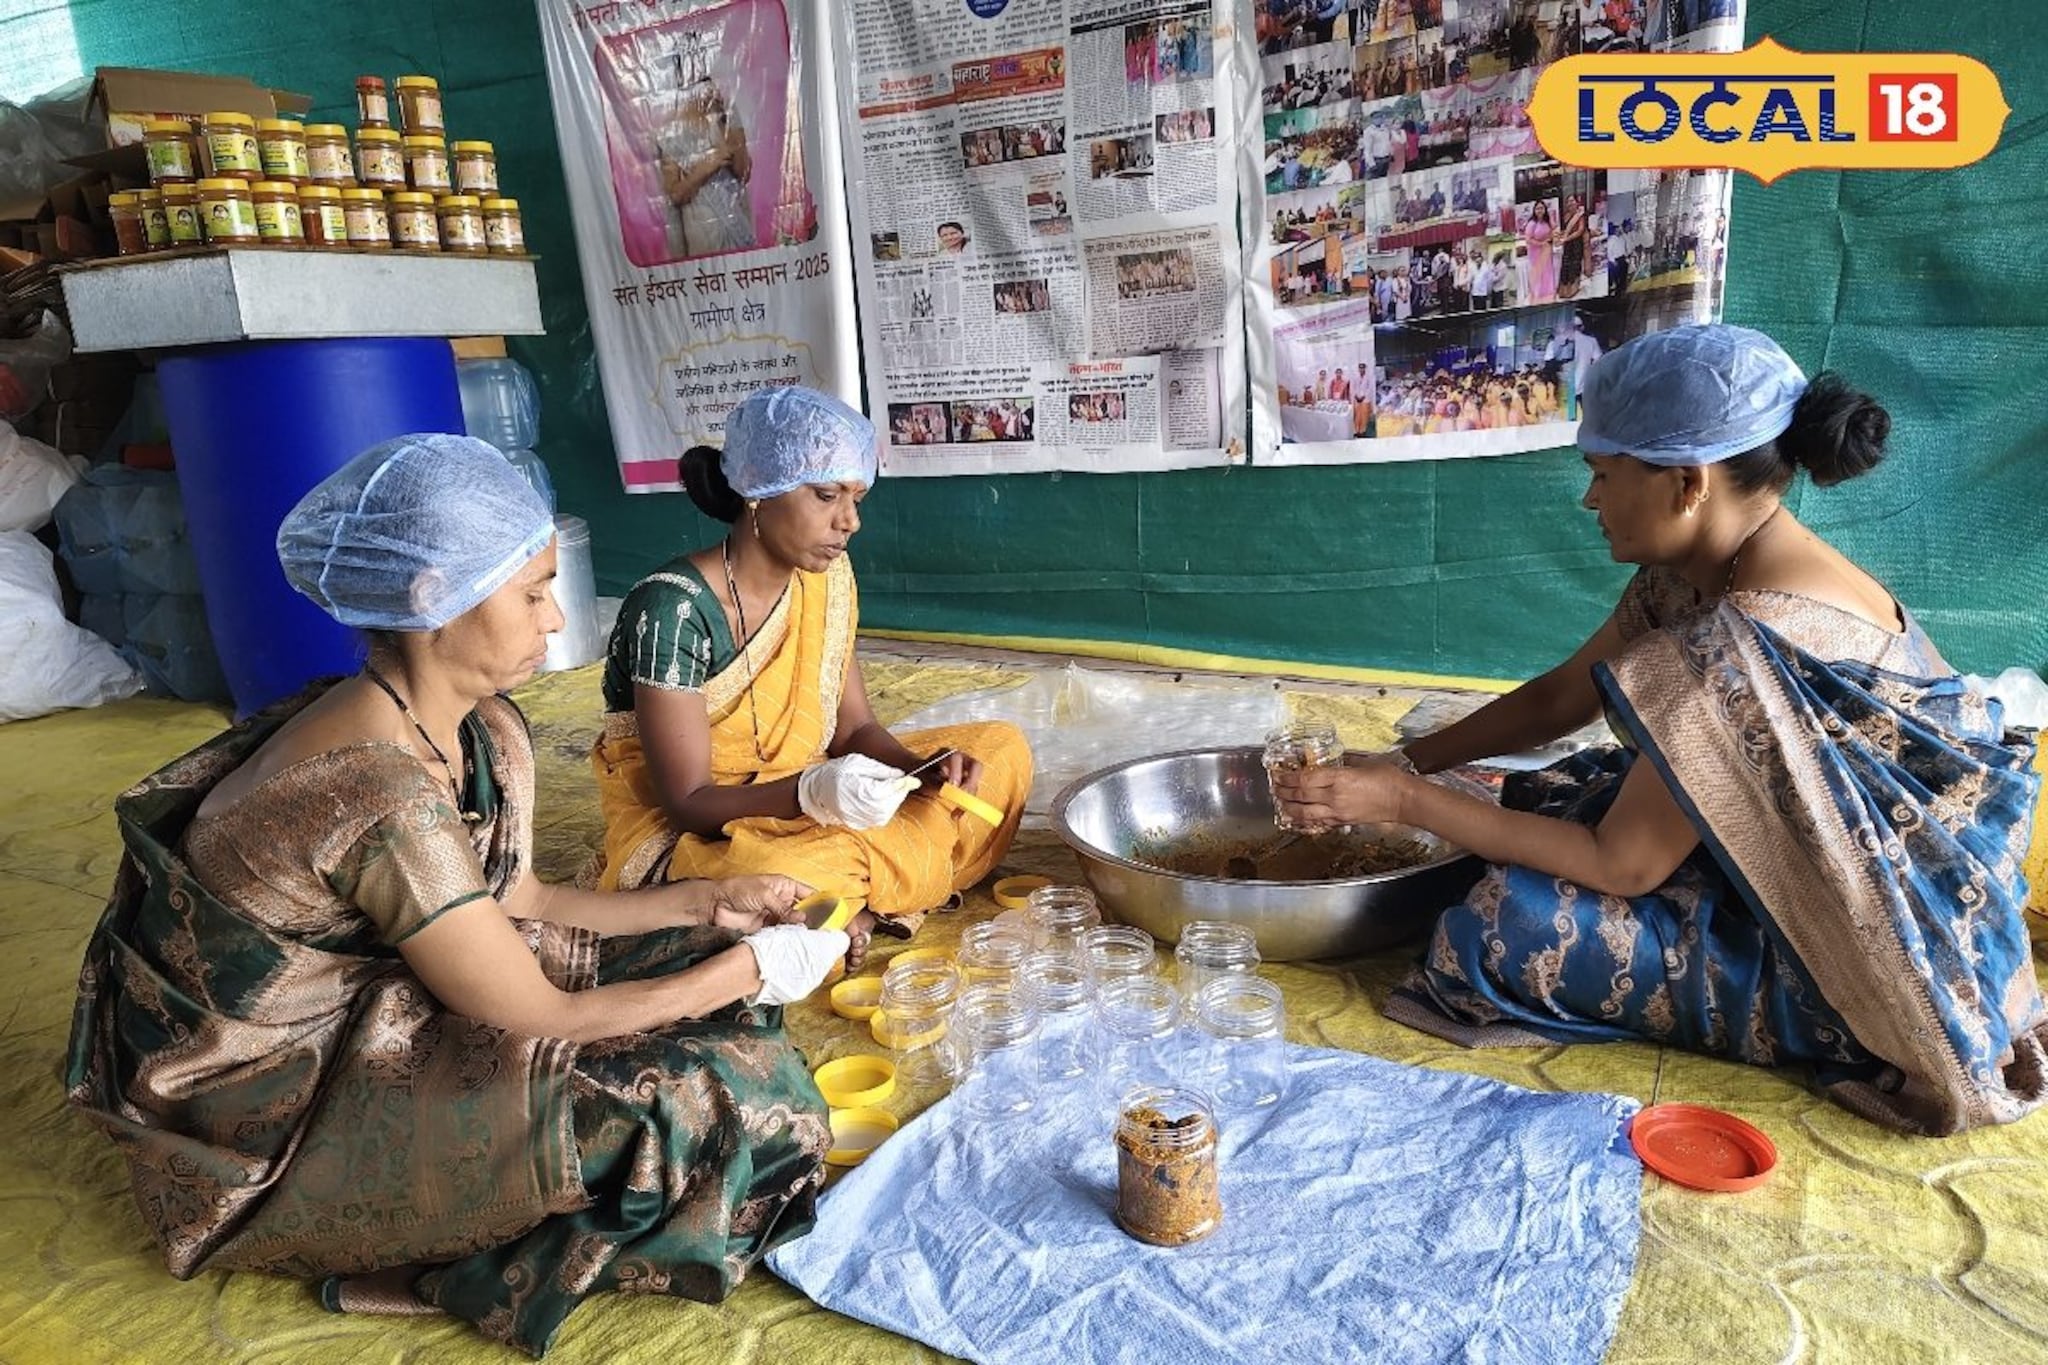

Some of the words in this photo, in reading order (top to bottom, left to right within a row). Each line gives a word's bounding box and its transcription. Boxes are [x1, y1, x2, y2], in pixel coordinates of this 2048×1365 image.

[612, 281, 640, 307] संत
[644, 274, 689, 307] ईश्वर
[692, 268, 726, 296] सेवा
[731, 262, 787, 291] सम्मान
[795, 253, 830, 281] 2025
[690, 302, 736, 330] ग्रामीण
[742, 298, 766, 327] क्षेत्र
